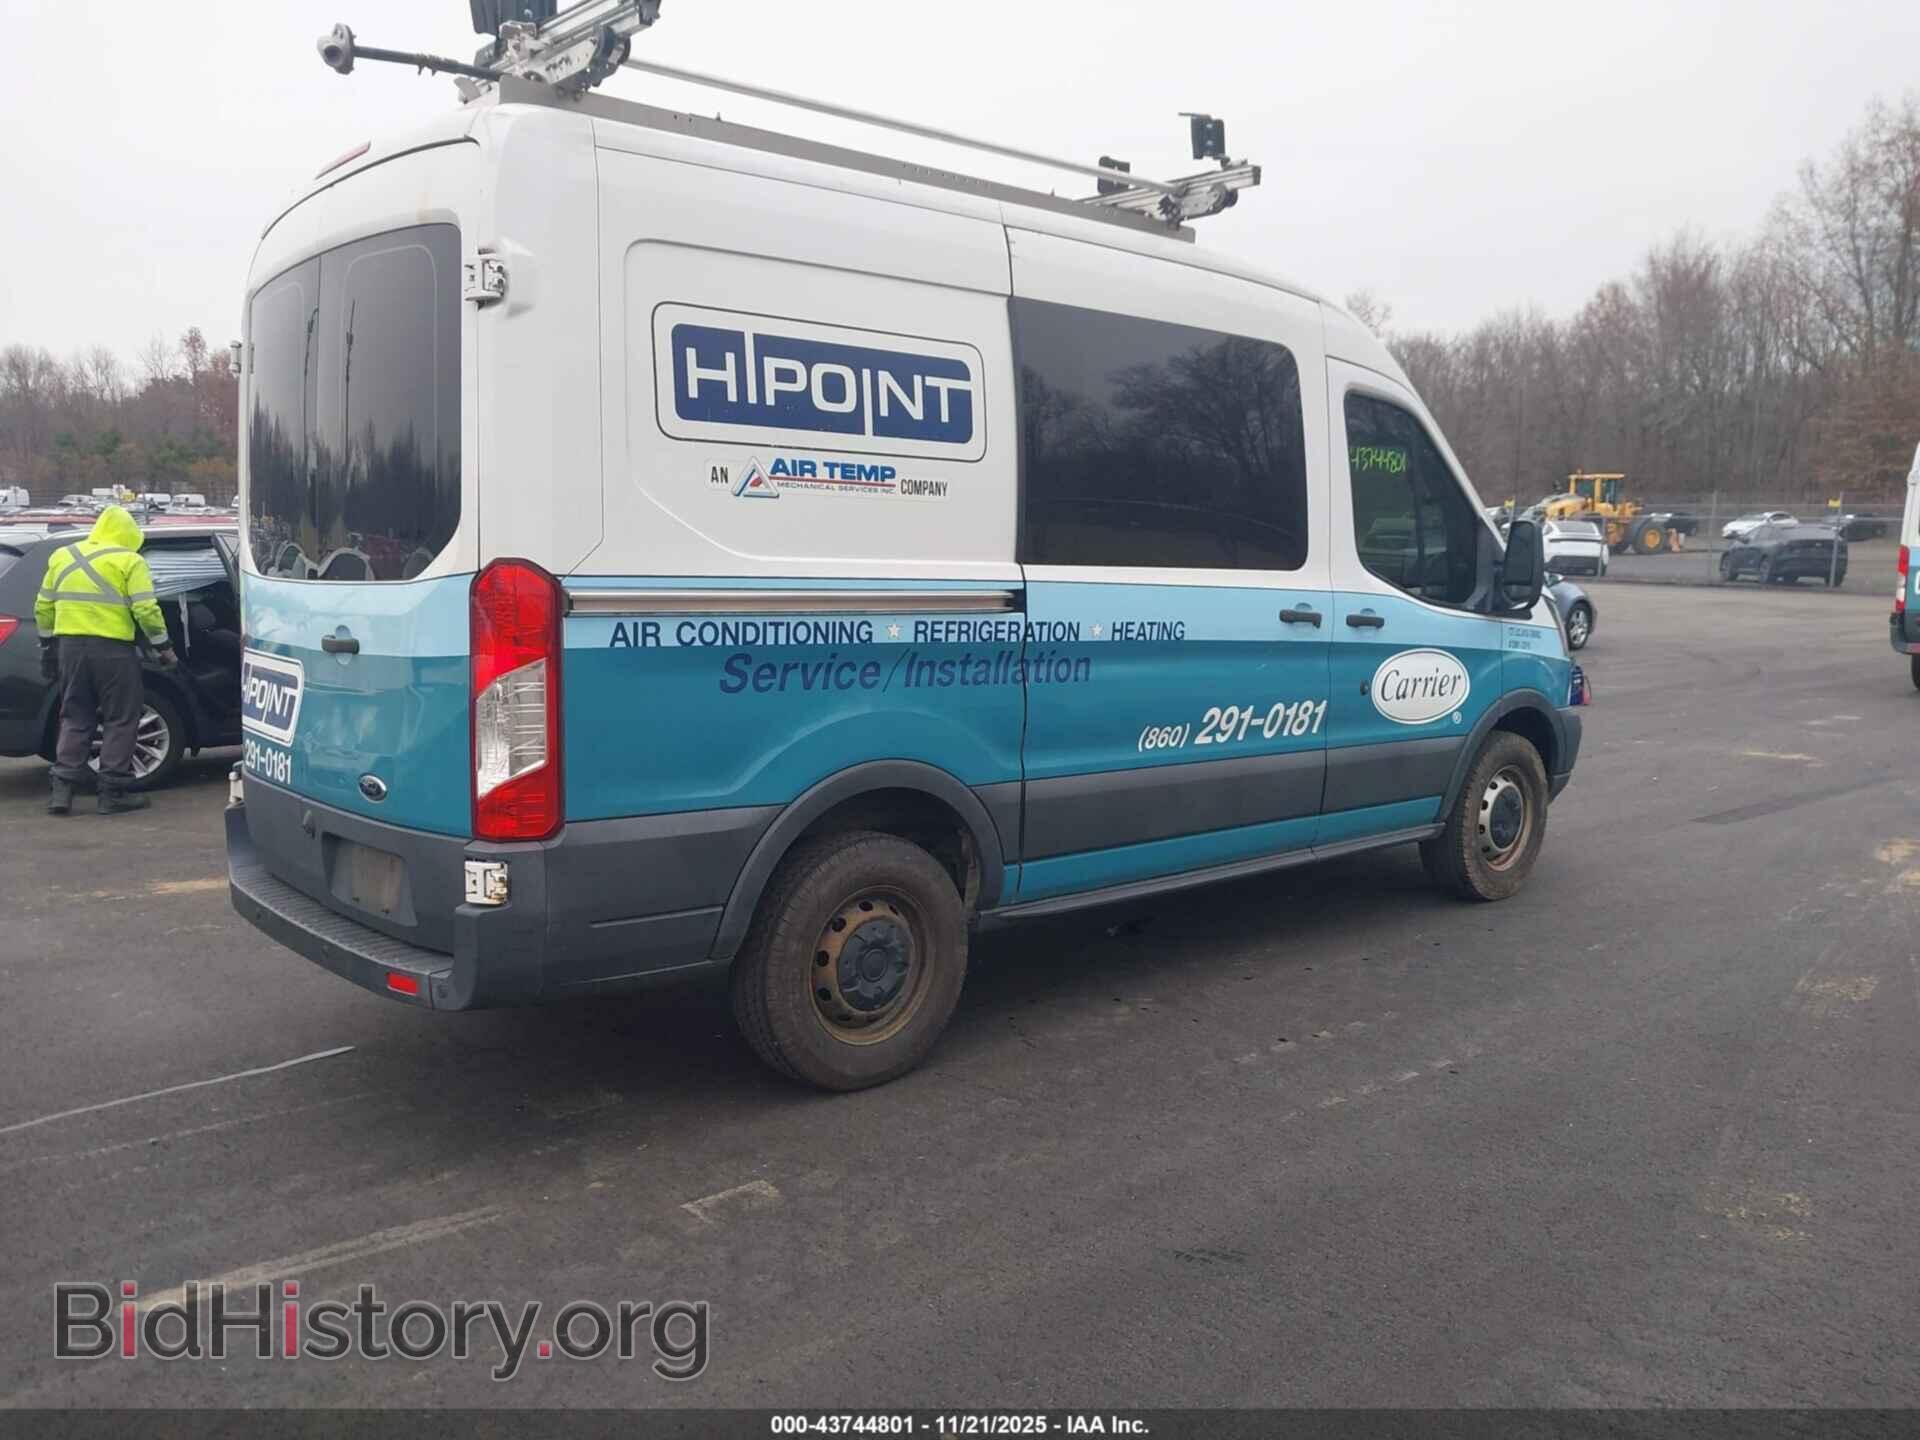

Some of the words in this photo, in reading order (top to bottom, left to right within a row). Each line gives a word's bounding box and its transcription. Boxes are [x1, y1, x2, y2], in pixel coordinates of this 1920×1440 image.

[710, 465, 729, 485] AN
[770, 457, 818, 478] AIR
[822, 460, 897, 483] TEMP
[776, 481, 836, 491] MECHANICAL
[838, 484, 880, 494] SERVICES
[900, 478, 949, 497] COMPANY
[609, 620, 662, 648] AIR
[676, 620, 874, 647] CONDITIONING
[913, 620, 1081, 643] REFRIGERATION
[1111, 620, 1186, 642] HEATING
[1380, 667, 1462, 703] Carrier
[1137, 723, 1191, 752] (860)
[1194, 700, 1328, 745] 291-0181
[244, 739, 292, 785] 291-0181
